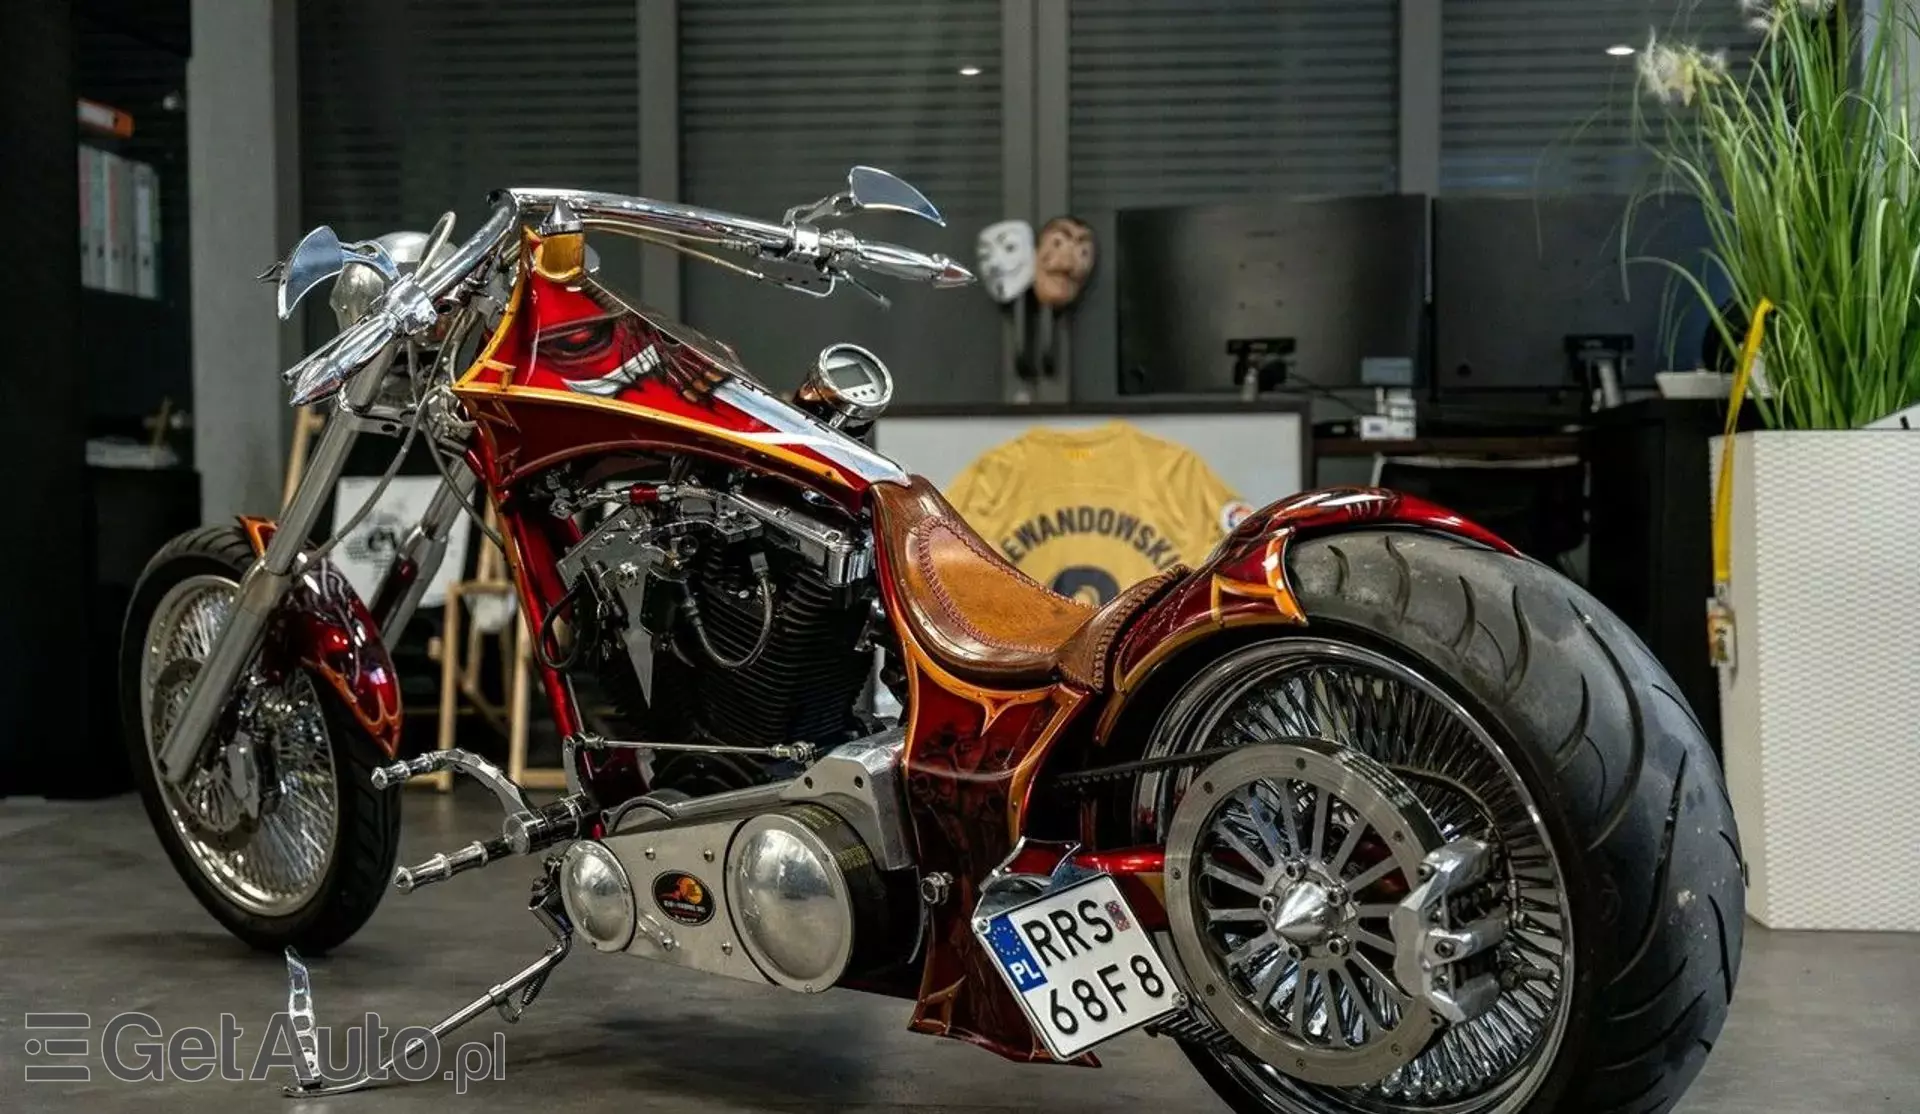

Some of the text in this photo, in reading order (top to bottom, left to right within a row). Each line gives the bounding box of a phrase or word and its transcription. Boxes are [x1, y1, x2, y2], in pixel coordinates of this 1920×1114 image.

[1001, 506, 1181, 569] EWANDOWSKI
[1022, 900, 1114, 967] RRS
[1009, 959, 1041, 985] PL
[1050, 954, 1165, 1035] 68F8
